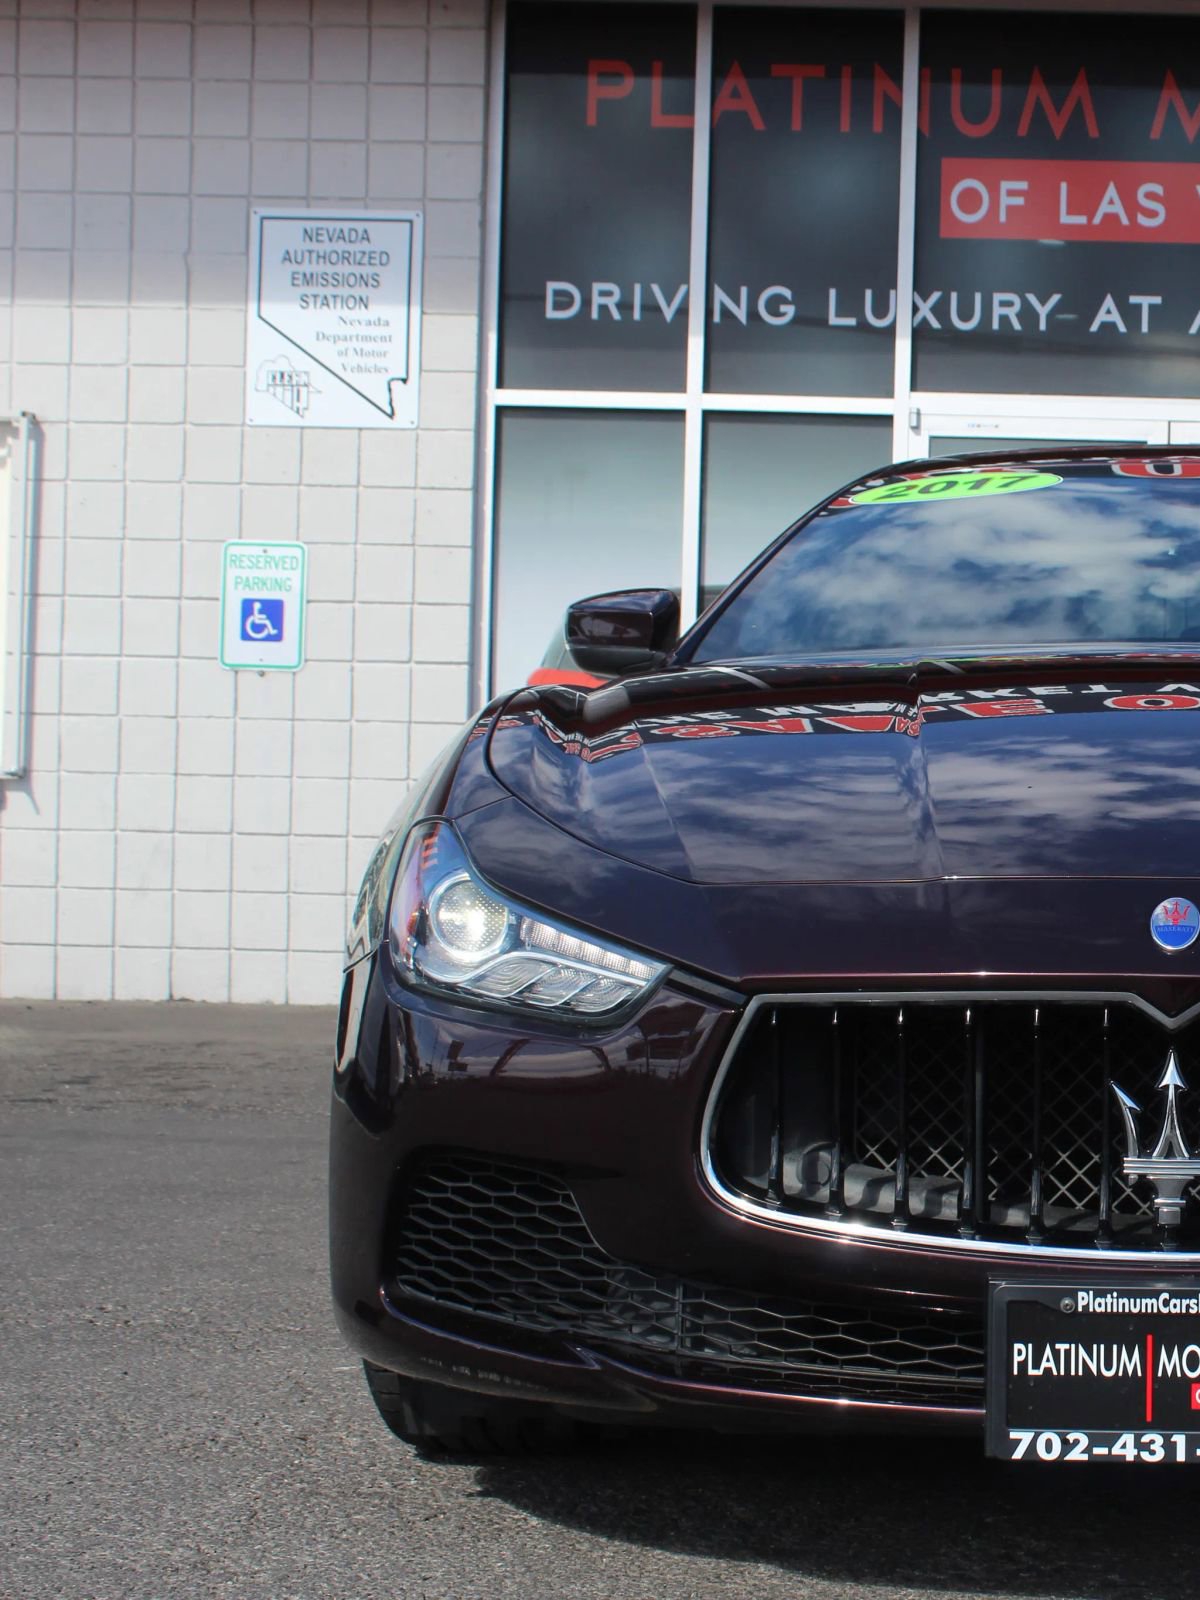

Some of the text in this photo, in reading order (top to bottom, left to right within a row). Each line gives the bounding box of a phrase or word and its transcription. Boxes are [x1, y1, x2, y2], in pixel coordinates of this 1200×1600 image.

[586, 59, 1099, 141] PLATINUM
[950, 178, 1028, 223] OF
[1059, 181, 1166, 227] LAS
[302, 227, 371, 244] NEVADA
[281, 249, 390, 267] AUTHORIZED
[290, 272, 380, 289] EMISSIONS
[298, 294, 369, 310] STATION
[545, 280, 796, 326] DRIVNG
[828, 287, 1062, 331] LUXURY
[1089, 293, 1162, 333] AT
[338, 315, 390, 327] Nevada
[315, 331, 392, 345] Department
[336, 349, 389, 359] of Motor
[341, 362, 389, 374] Vehicles
[872, 475, 1040, 500] 2017
[229, 554, 299, 571] RESERVED
[234, 576, 292, 592] PARKING
[1012, 1342, 1142, 1377] PLATINUM
